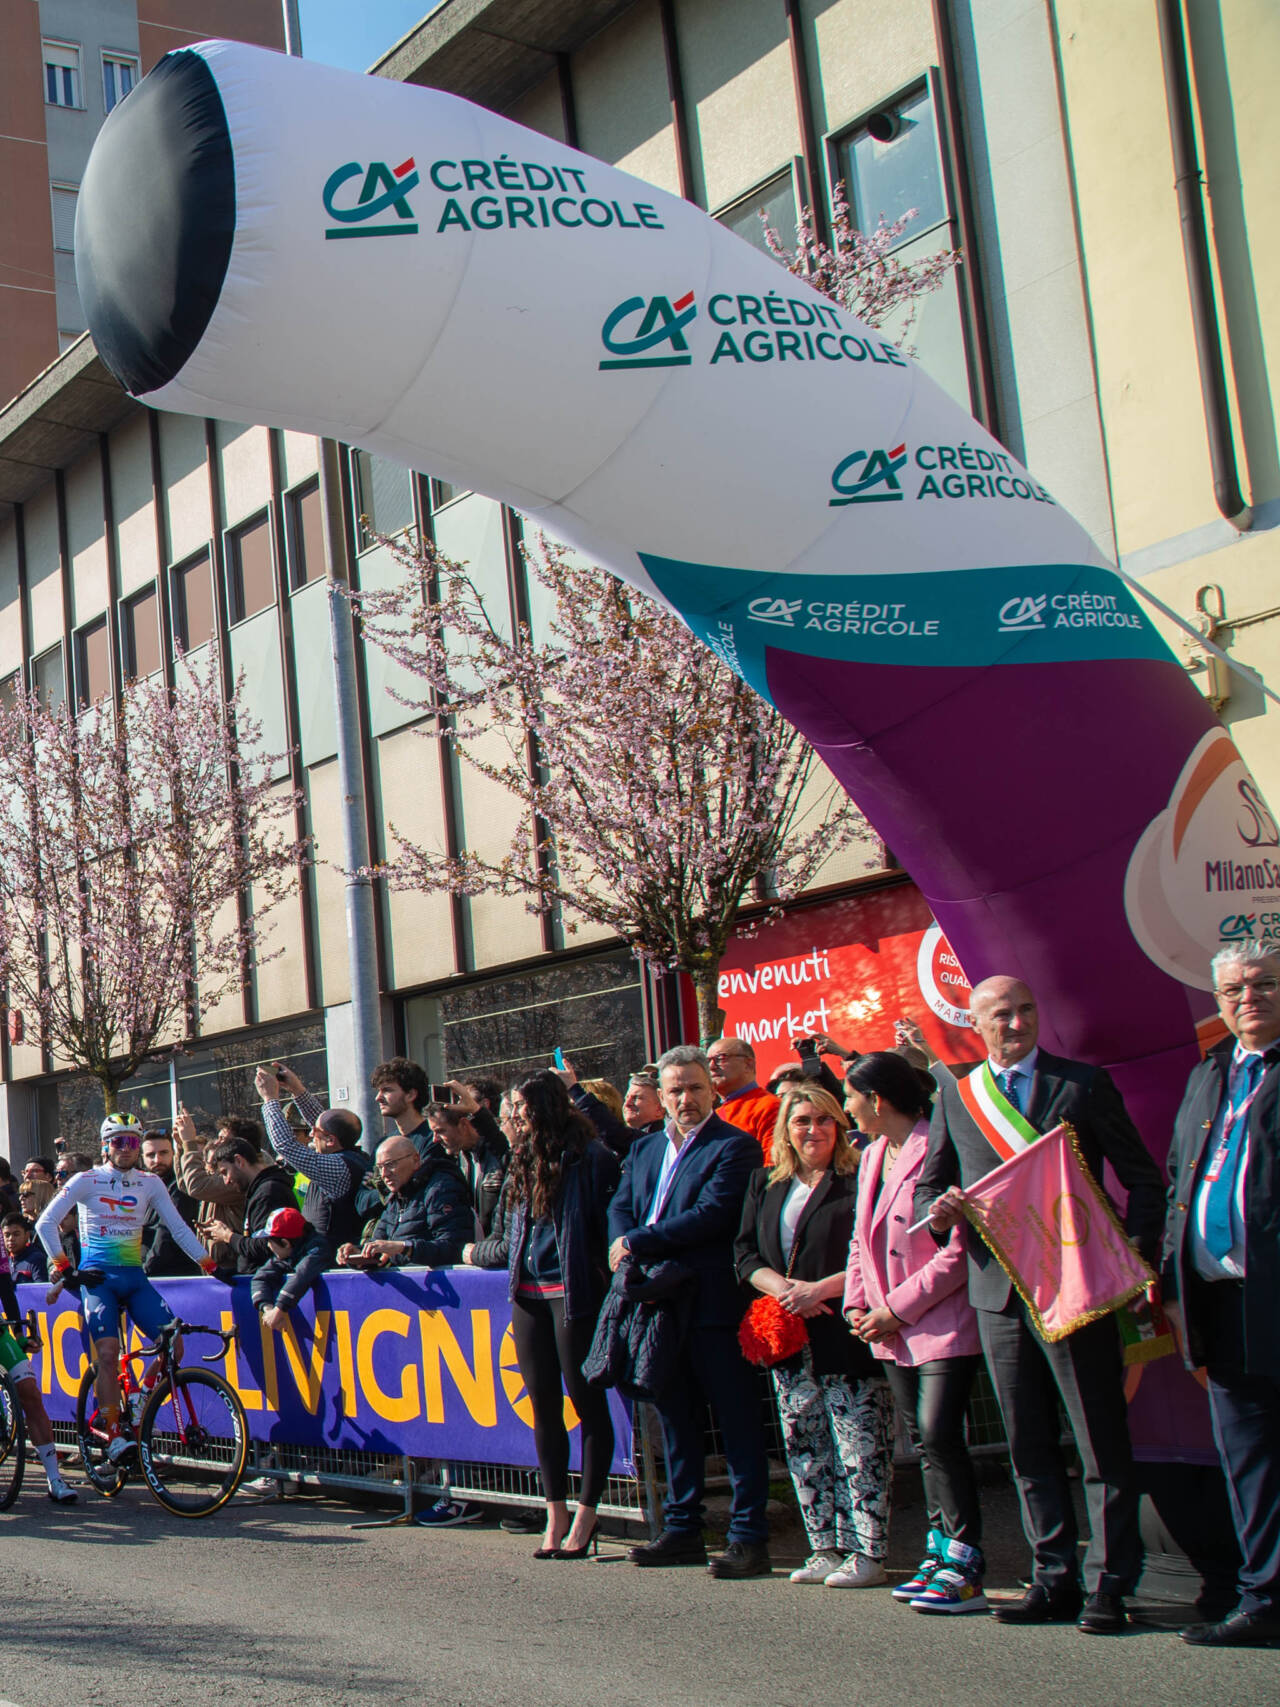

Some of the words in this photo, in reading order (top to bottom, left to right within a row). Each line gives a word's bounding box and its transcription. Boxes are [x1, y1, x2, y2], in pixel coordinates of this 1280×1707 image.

[430, 154, 587, 194] CRÉDIT
[436, 196, 665, 233] AGRICOLE
[707, 290, 843, 330] CRÉDIT
[709, 330, 908, 367] AGRICOLE
[915, 442, 1013, 474] CRÉDIT
[917, 474, 1057, 506] AGRICOLE
[807, 600, 906, 619] CRÉDIT
[1051, 590, 1117, 611] CRÉDIT
[804, 616, 940, 636] AGRICOLE
[1053, 611, 1144, 630] AGRICOLE
[718, 946, 831, 998] envenuti
[736, 998, 832, 1044] market
